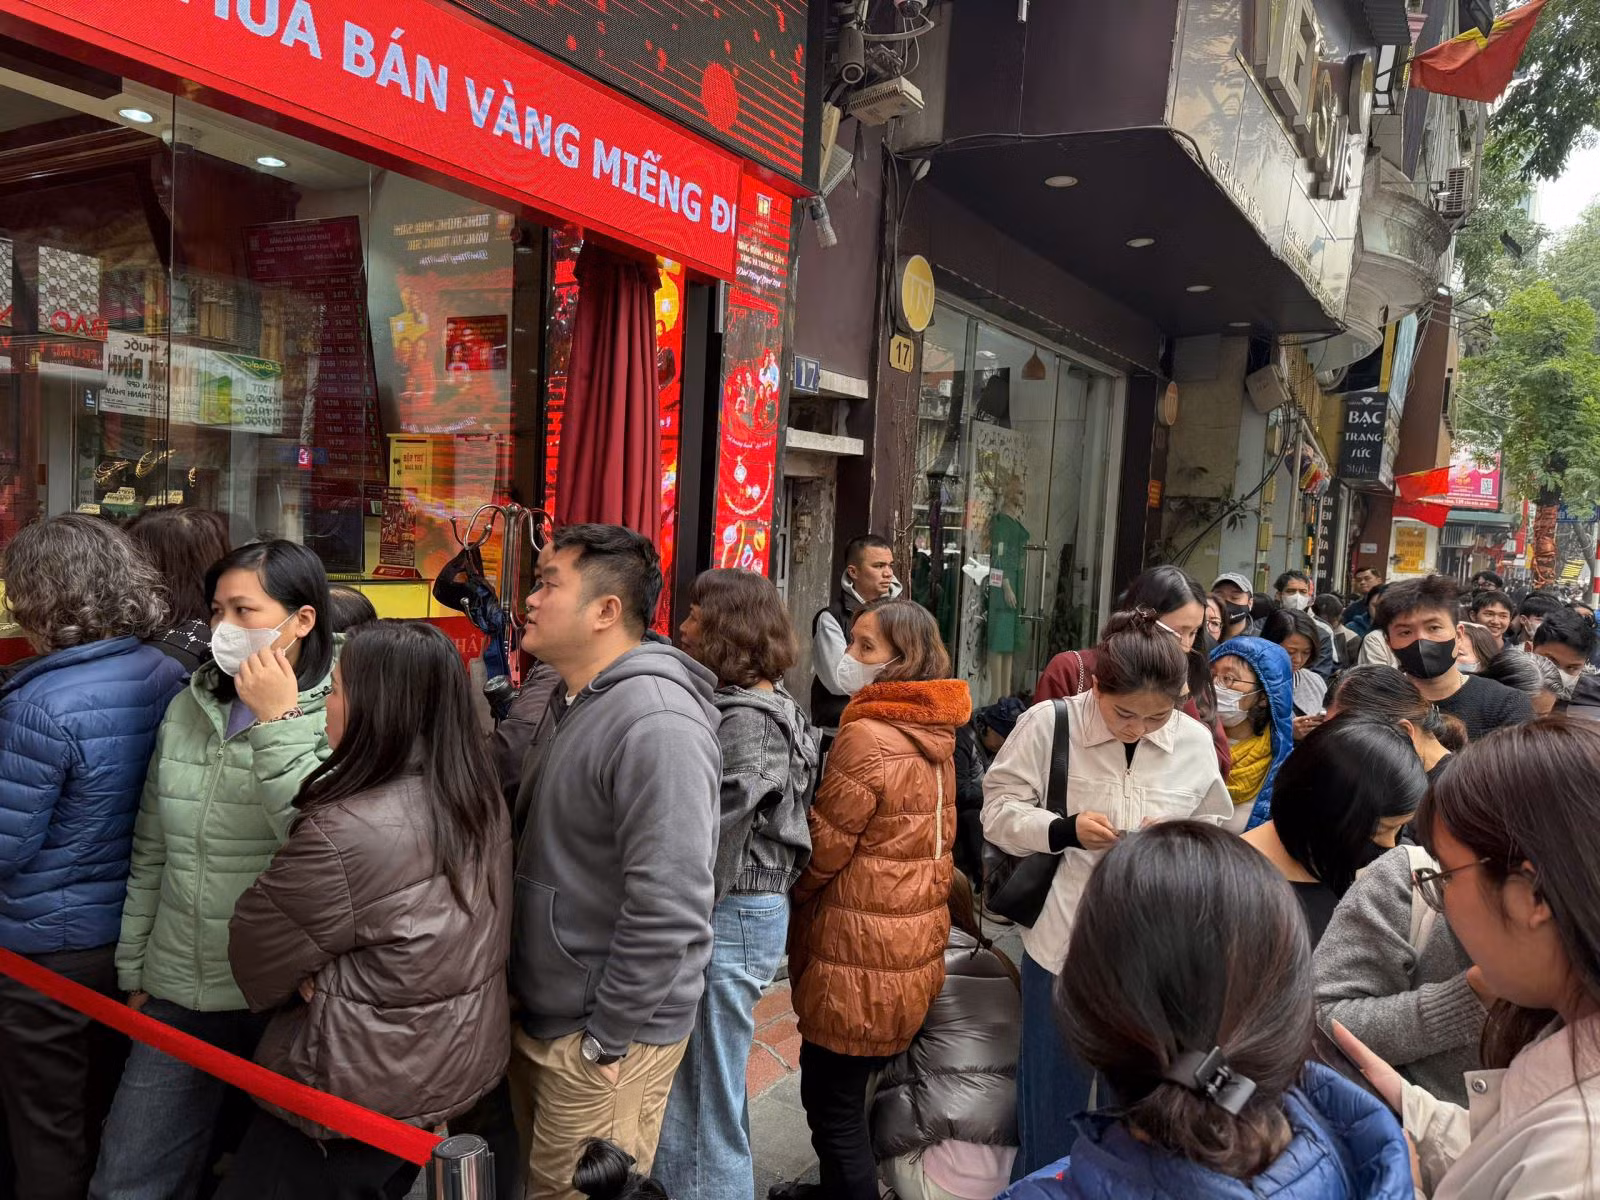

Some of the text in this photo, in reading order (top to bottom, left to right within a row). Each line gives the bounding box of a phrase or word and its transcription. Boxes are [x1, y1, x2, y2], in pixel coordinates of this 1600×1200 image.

[343, 20, 448, 113] BÁN
[464, 76, 580, 169] VÀNG
[896, 342, 910, 366] 17
[800, 361, 817, 389] 17
[1348, 411, 1382, 427] BẠC
[1345, 432, 1382, 442] TRANG
